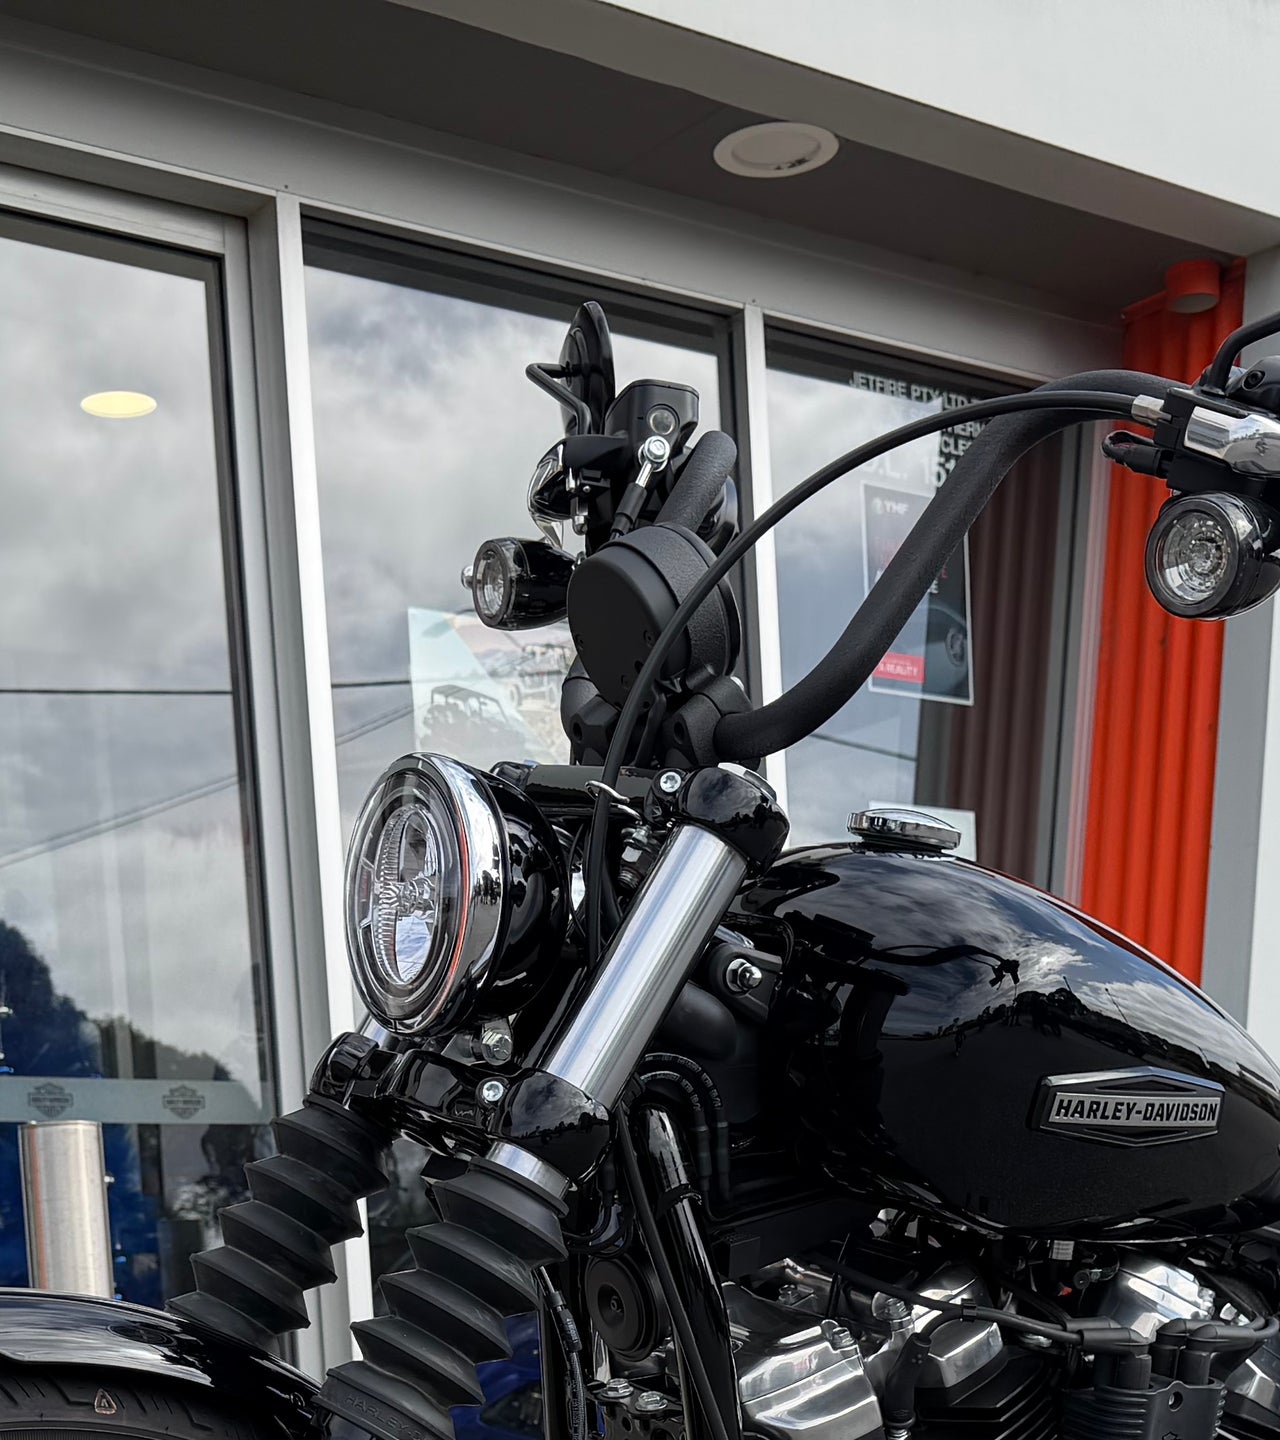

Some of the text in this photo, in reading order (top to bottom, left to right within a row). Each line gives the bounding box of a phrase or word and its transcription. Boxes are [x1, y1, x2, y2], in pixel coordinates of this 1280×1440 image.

[849, 371, 907, 397] JETFIRE
[910, 383, 941, 401] PTY
[1055, 1098, 1219, 1122] HARLEY-DAVIDSON
